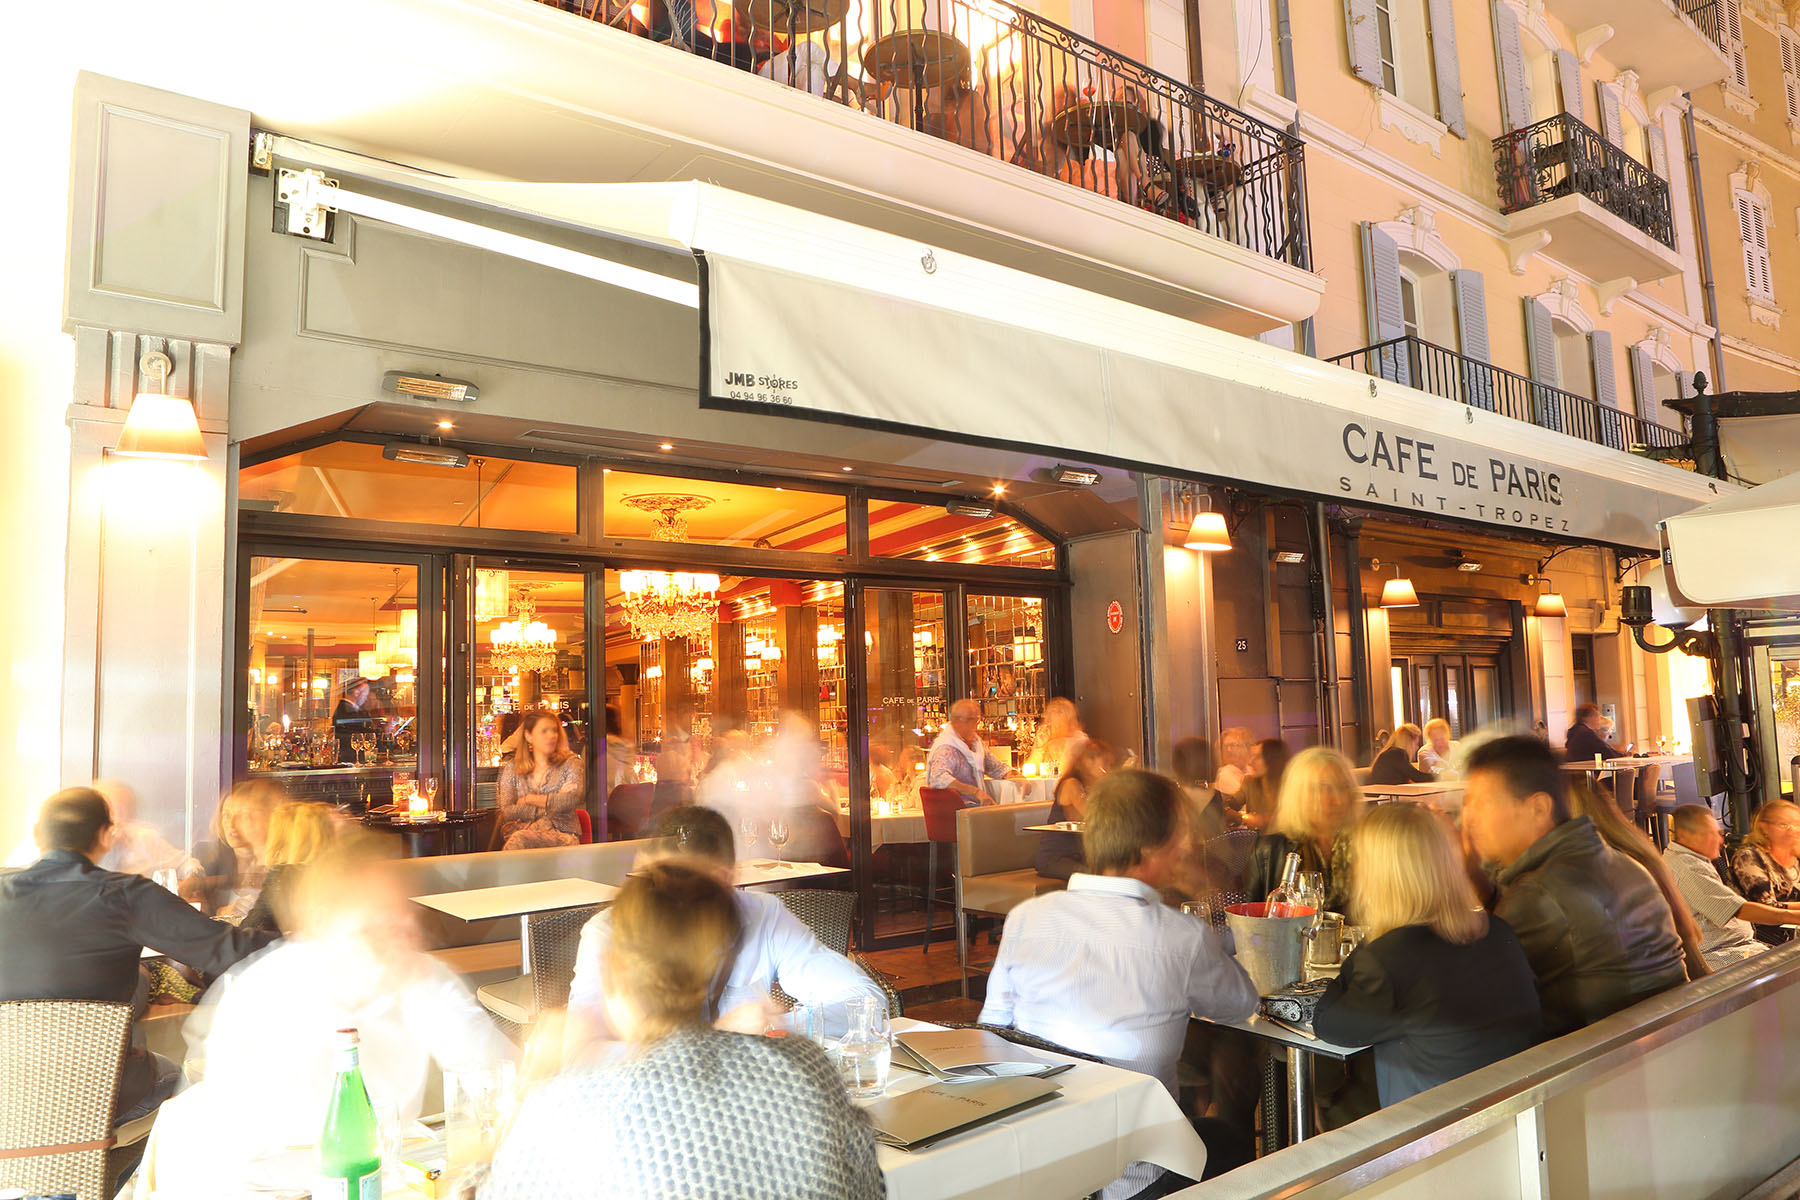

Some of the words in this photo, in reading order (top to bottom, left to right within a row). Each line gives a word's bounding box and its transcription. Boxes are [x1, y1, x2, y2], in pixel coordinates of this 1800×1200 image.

[725, 372, 756, 387] JMB
[758, 375, 799, 391] STORES
[730, 390, 742, 400] 04
[743, 391, 755, 401] 94
[757, 392, 768, 402] 96
[770, 394, 781, 404] 36
[782, 396, 793, 405] 60
[1342, 422, 1438, 481] CAFE
[1452, 461, 1479, 490] DE
[1489, 458, 1564, 506] PARIS
[1339, 476, 1569, 532] SAINT-TROPEZ
[1237, 641, 1247, 650] 25
[490, 702, 521, 711] CE
[882, 696, 905, 704] CAFE
[916, 696, 940, 704] PARIS
